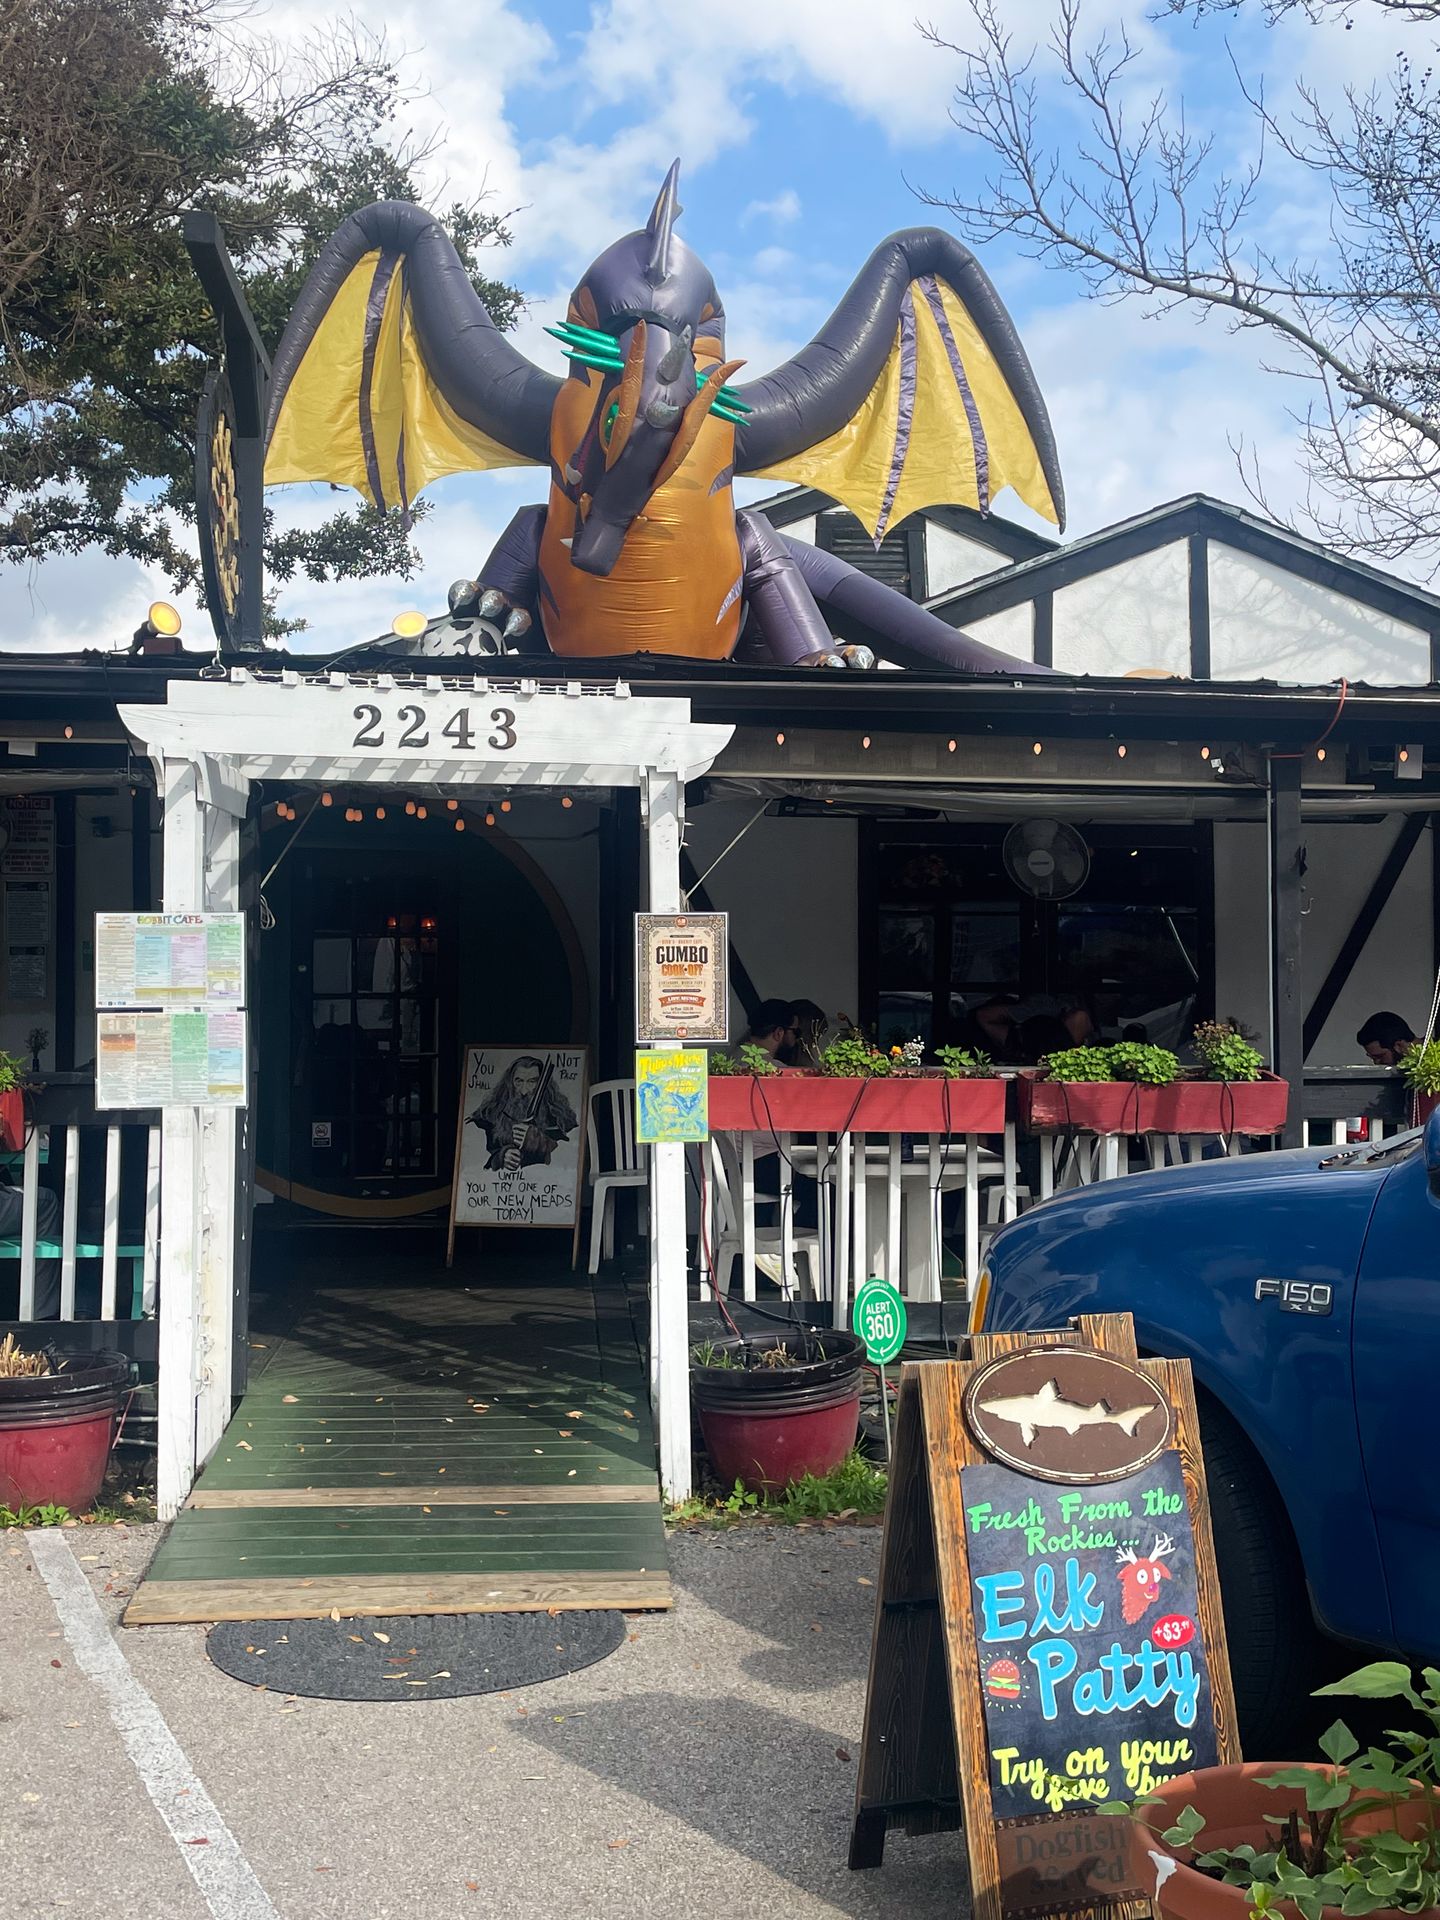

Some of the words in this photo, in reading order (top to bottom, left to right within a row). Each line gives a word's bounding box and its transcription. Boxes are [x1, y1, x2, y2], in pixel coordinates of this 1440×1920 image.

[352, 704, 517, 750] 2243
[137, 915, 172, 925] HOBBIT
[655, 945, 709, 965] GUMBO
[498, 1171, 525, 1181] UNTIL
[466, 1182, 486, 1193] YOU
[493, 1182, 512, 1193] TRY
[518, 1182, 537, 1193] ONE
[544, 1184, 558, 1194] OF
[467, 1196, 491, 1207] OUR
[497, 1196, 525, 1206] NEW
[530, 1195, 573, 1209] MEADS
[492, 1207, 534, 1223] TODAY!
[866, 1301, 891, 1315] ALERT
[1290, 1303, 1319, 1313] XL
[866, 1313, 894, 1342] 360
[966, 1497, 1046, 1534] Fresh
[1057, 1490, 1132, 1524] From
[1141, 1487, 1184, 1519] the
[974, 1557, 1105, 1643] Elk
[1027, 1638, 1201, 1729] Patty
[992, 1746, 1050, 1800] Try
[1065, 1746, 1110, 1777] on
[1120, 1737, 1192, 1789] your
[1015, 1822, 1128, 1864] Dogfish
